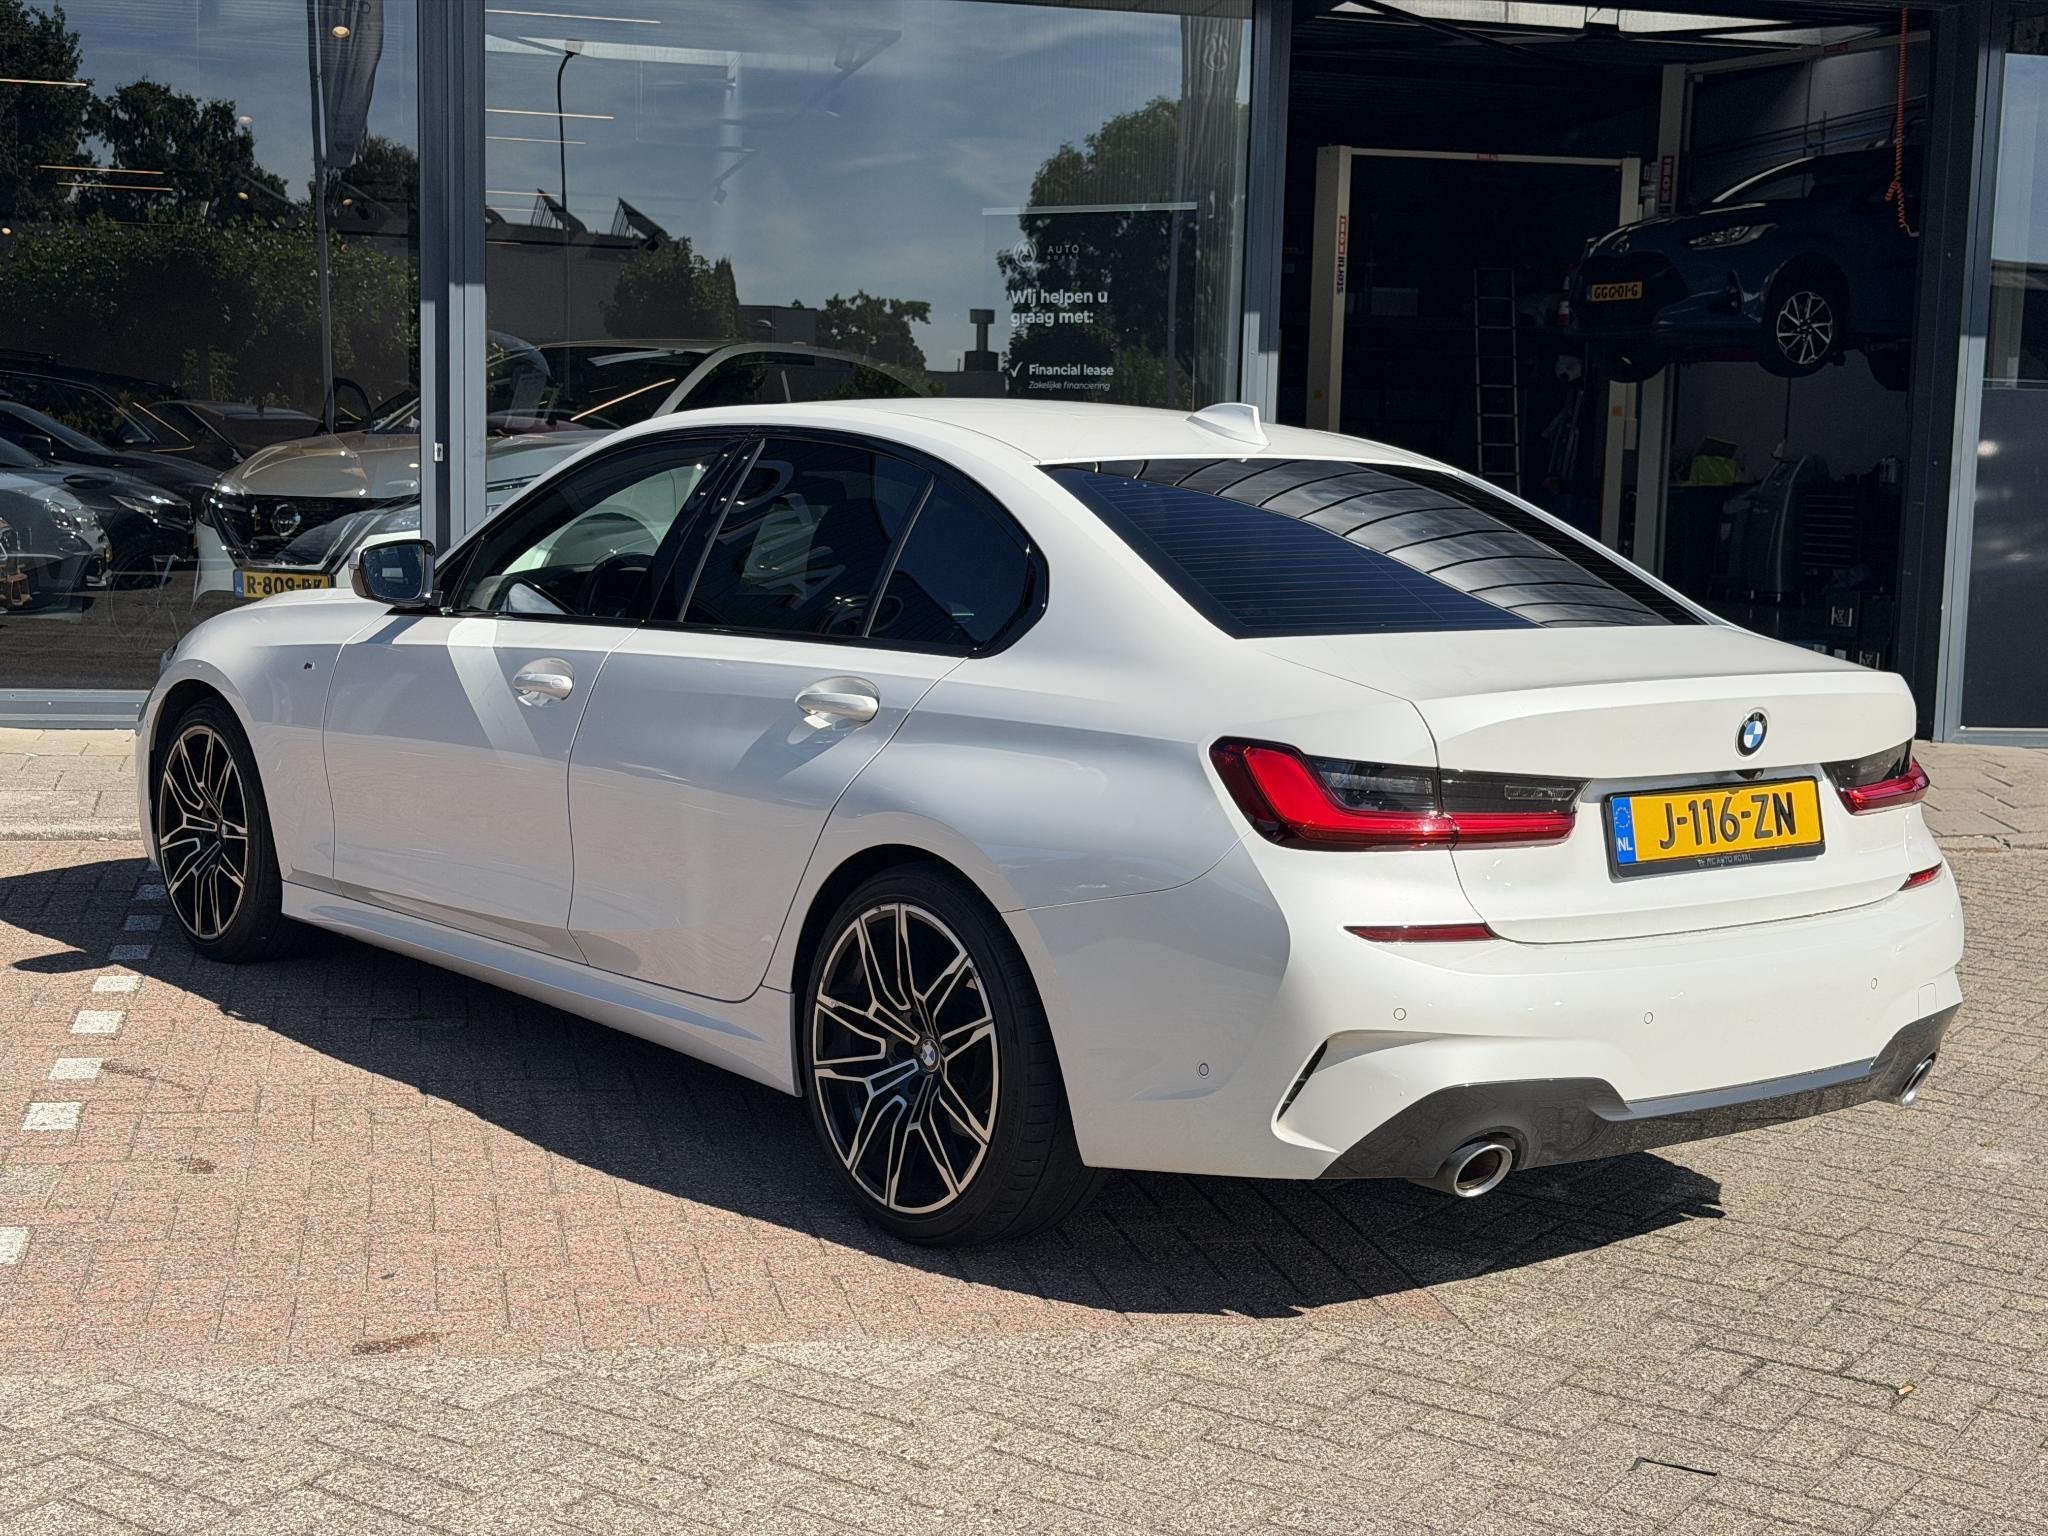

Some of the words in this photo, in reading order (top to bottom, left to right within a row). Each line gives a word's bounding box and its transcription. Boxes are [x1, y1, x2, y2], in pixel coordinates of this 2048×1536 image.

[1047, 244, 1080, 254] AUTO
[1010, 288, 1037, 307] Wij
[1040, 288, 1094, 307] helpen
[1097, 291, 1108, 304] u
[1010, 312, 1055, 327] graag
[1059, 310, 1094, 324] met:
[1029, 363, 1081, 376] Financial
[1083, 363, 1114, 376] lease
[1028, 381, 1061, 391] Zakelijke
[1616, 837, 1634, 852] NL
[1659, 791, 1797, 850] J-116-ZN
